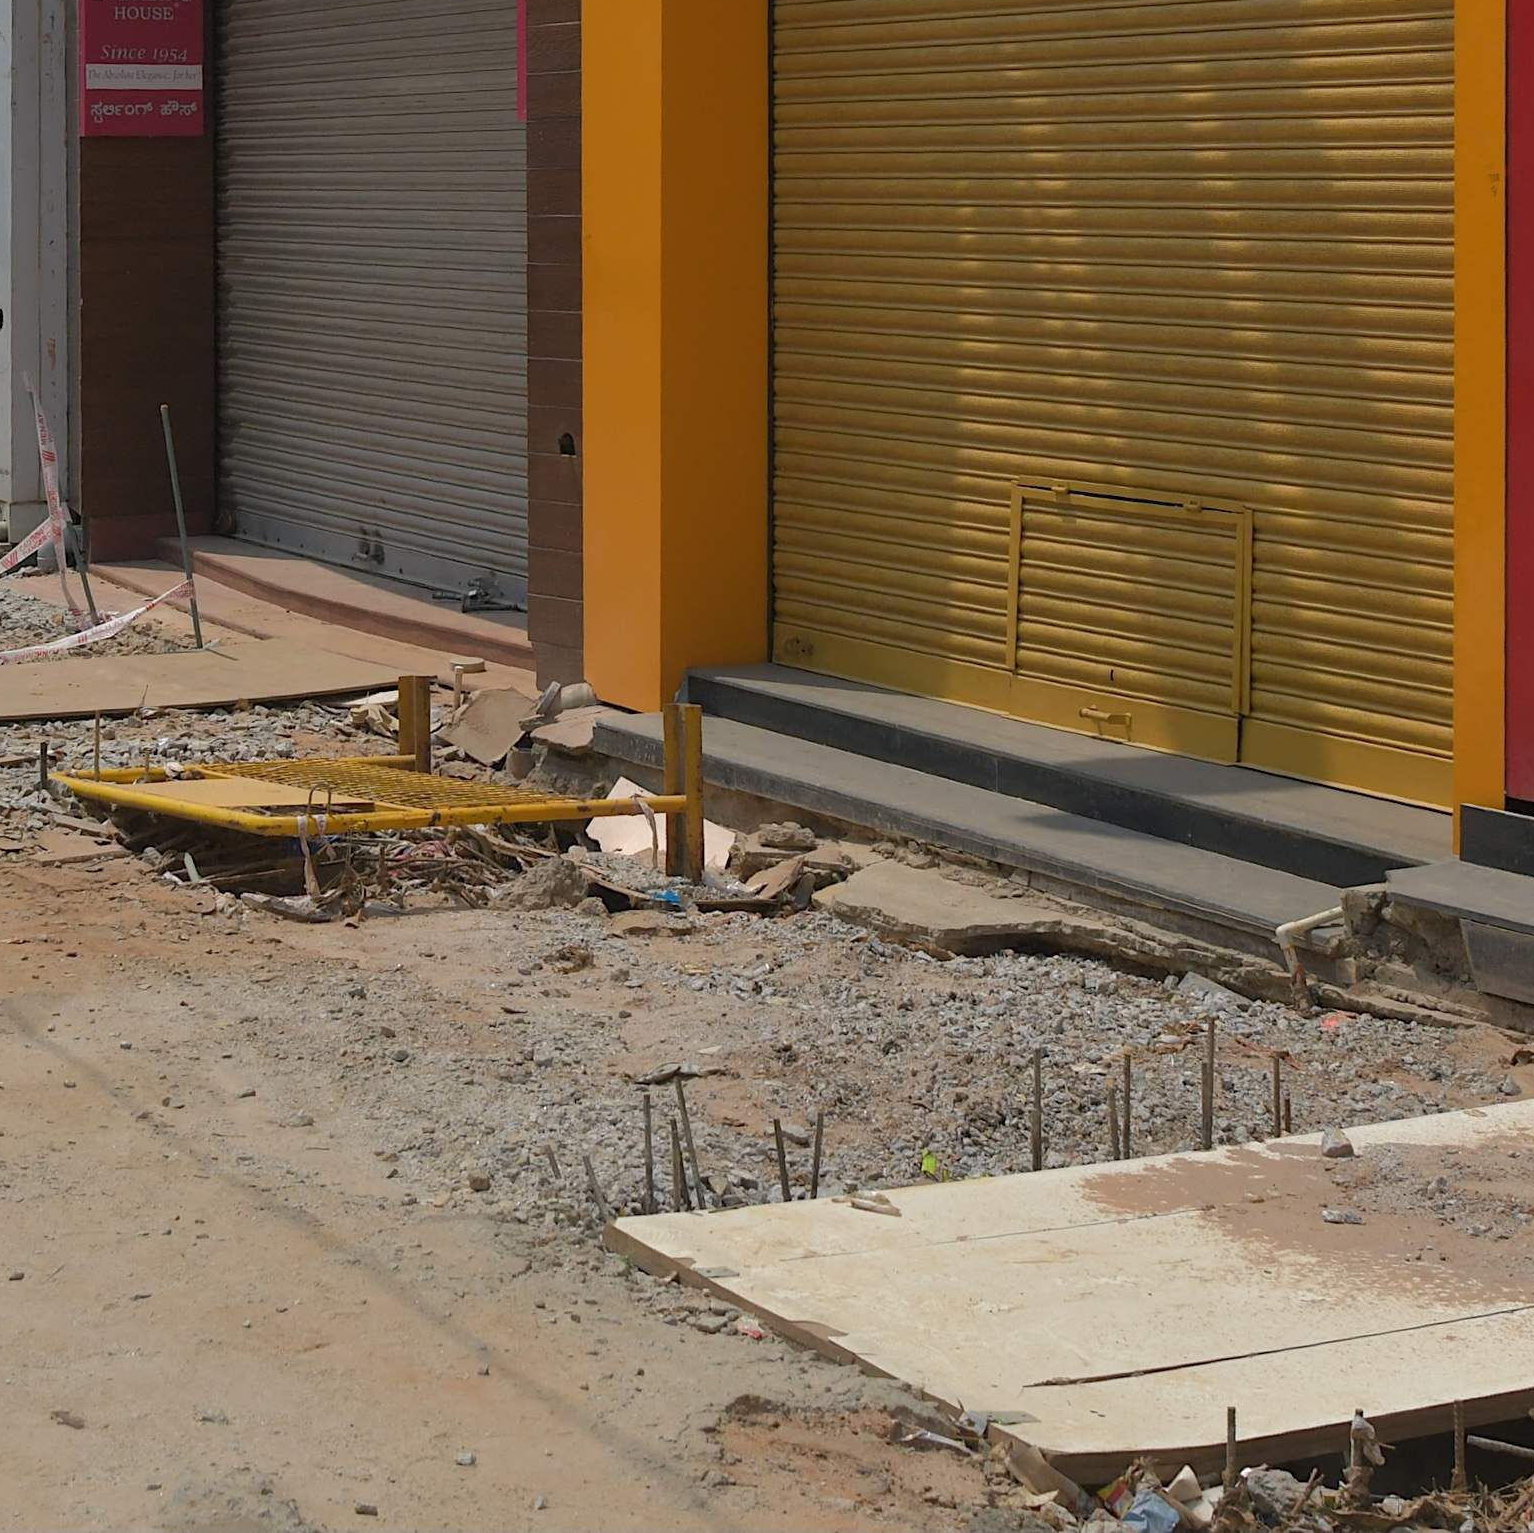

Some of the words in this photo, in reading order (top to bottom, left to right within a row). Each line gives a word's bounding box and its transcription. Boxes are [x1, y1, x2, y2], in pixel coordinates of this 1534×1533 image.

[114, 5, 175, 20] HOUSE
[100, 45, 148, 60] Since
[152, 47, 188, 63] 1954
